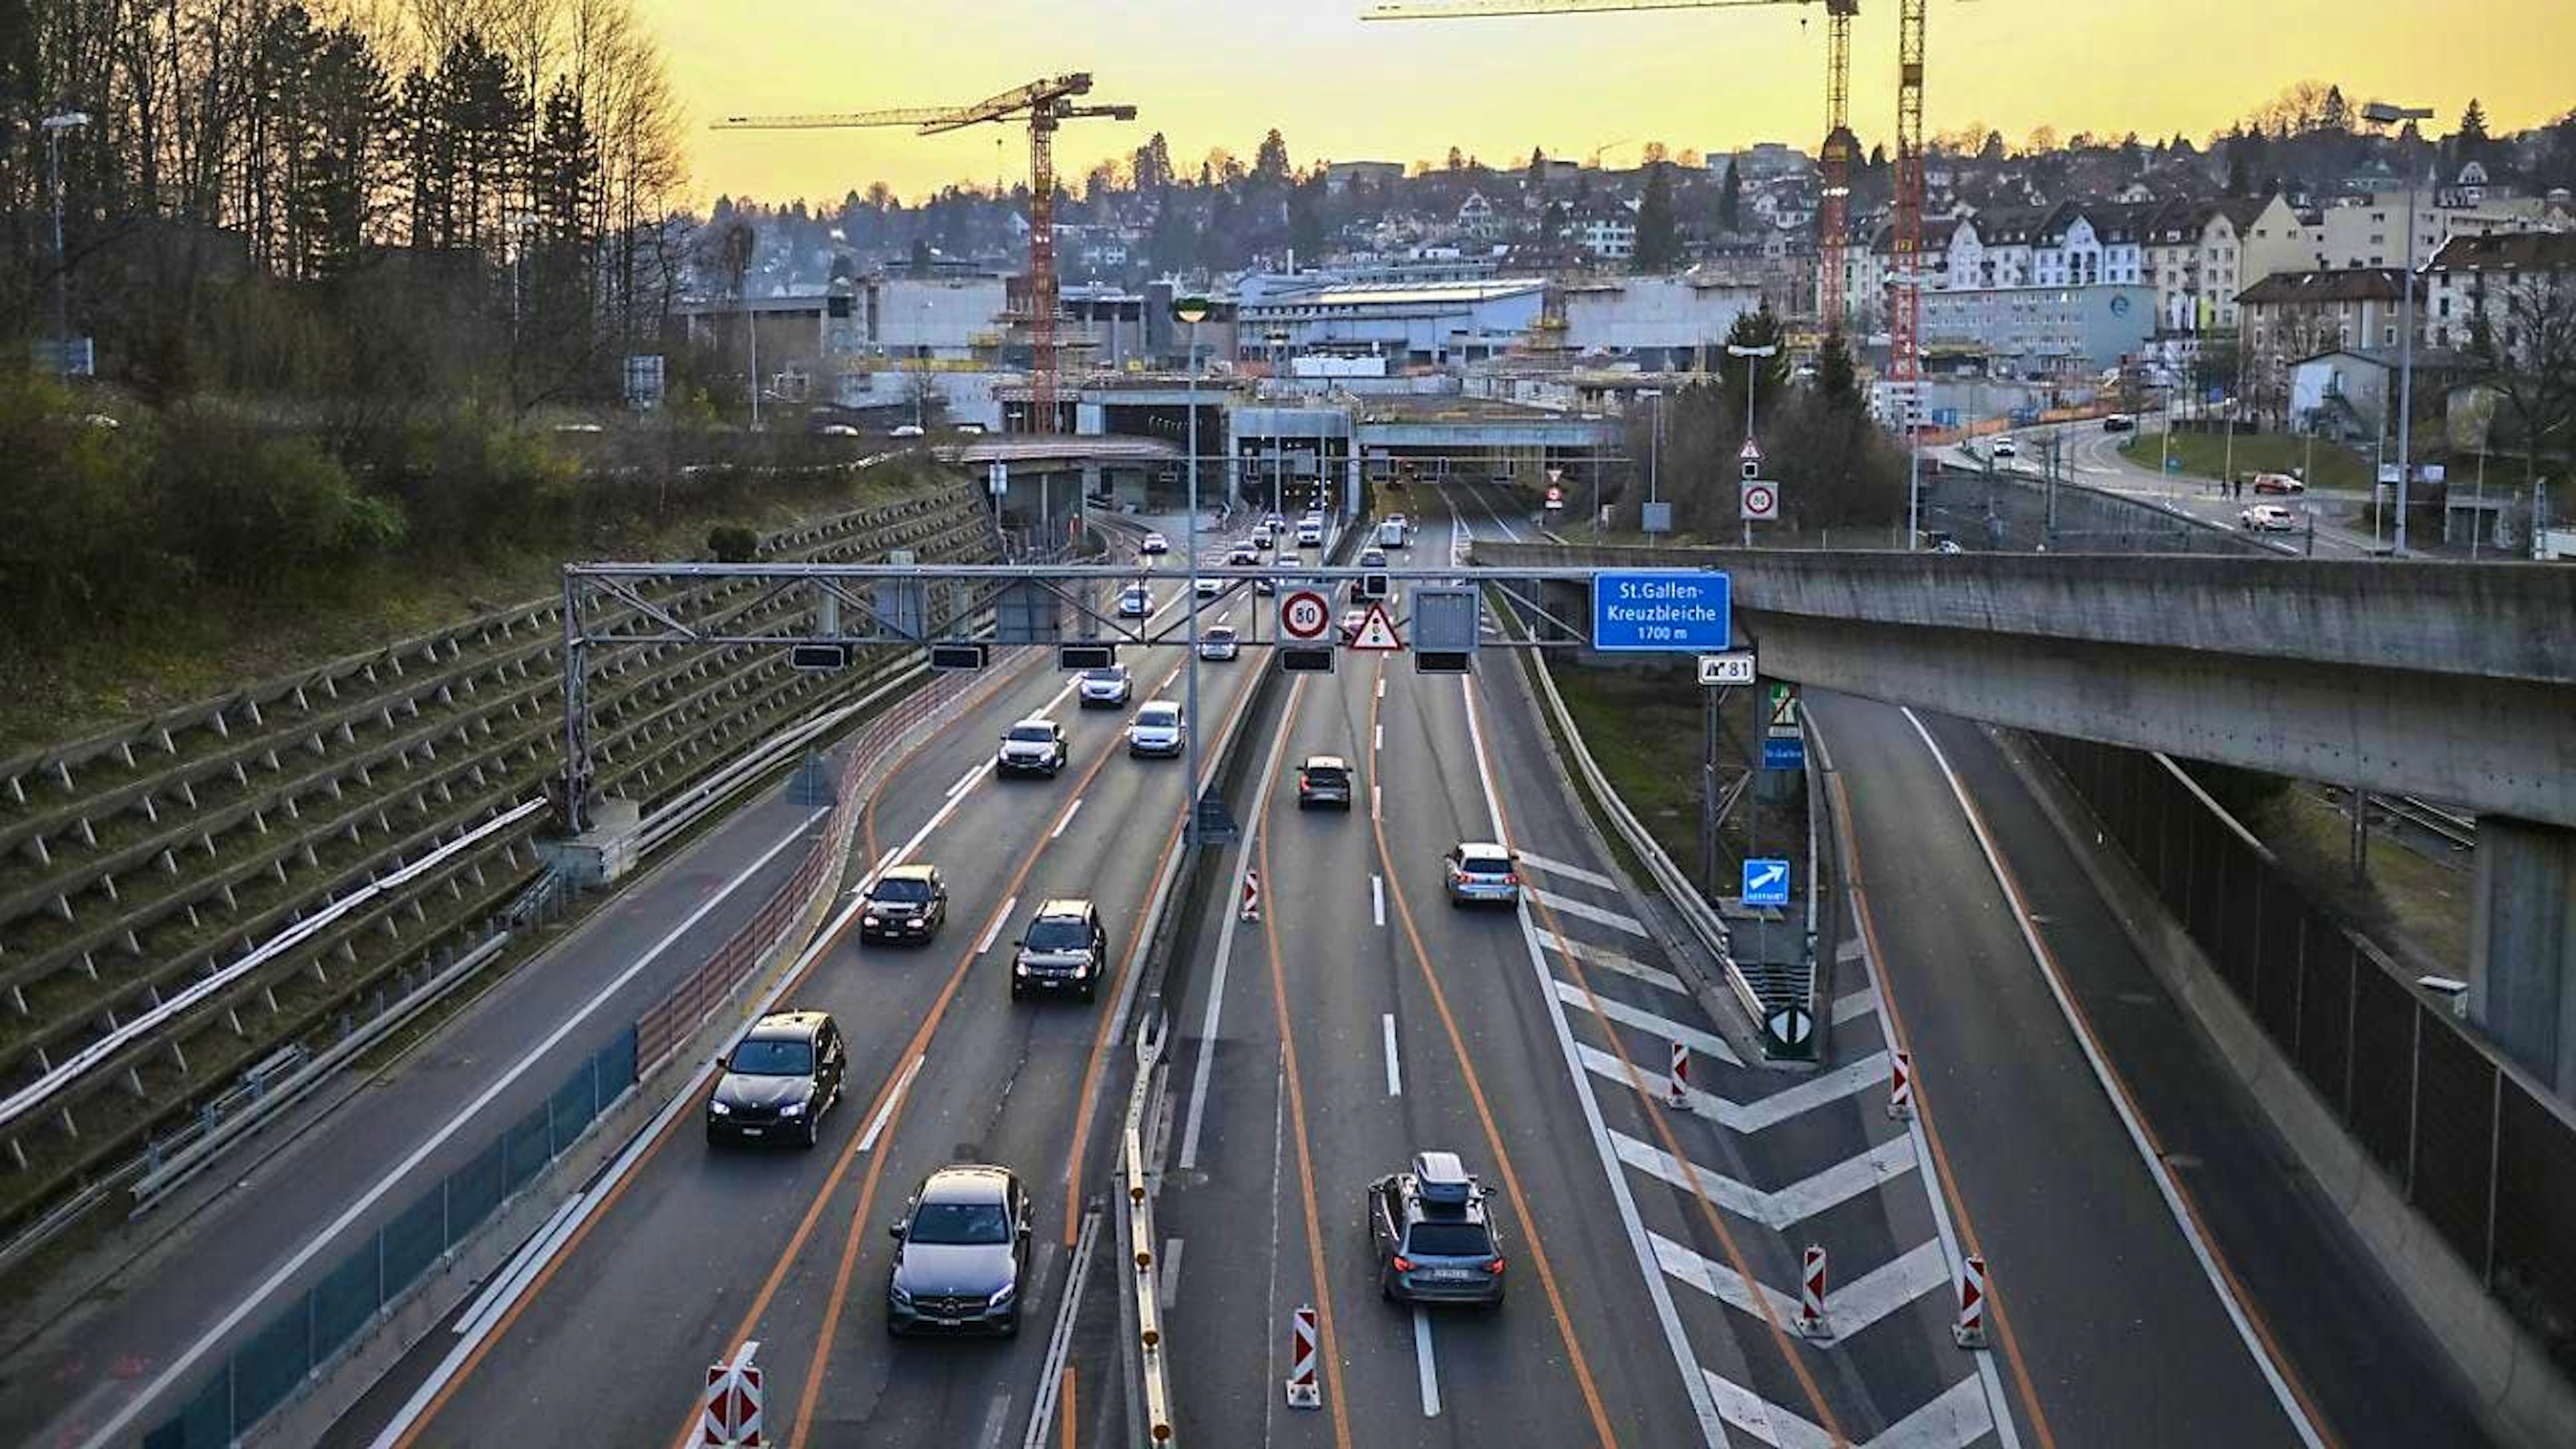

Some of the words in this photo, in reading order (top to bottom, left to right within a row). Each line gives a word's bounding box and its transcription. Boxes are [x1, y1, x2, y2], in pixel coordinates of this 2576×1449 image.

[1619, 582, 1704, 598] St.Gallen-
[1296, 608, 1314, 623] 80
[1607, 604, 1715, 621] Kreuzbleiche
[1639, 626, 1670, 639] 1700
[1674, 629, 1687, 639] m
[1729, 662, 1747, 676] 81
